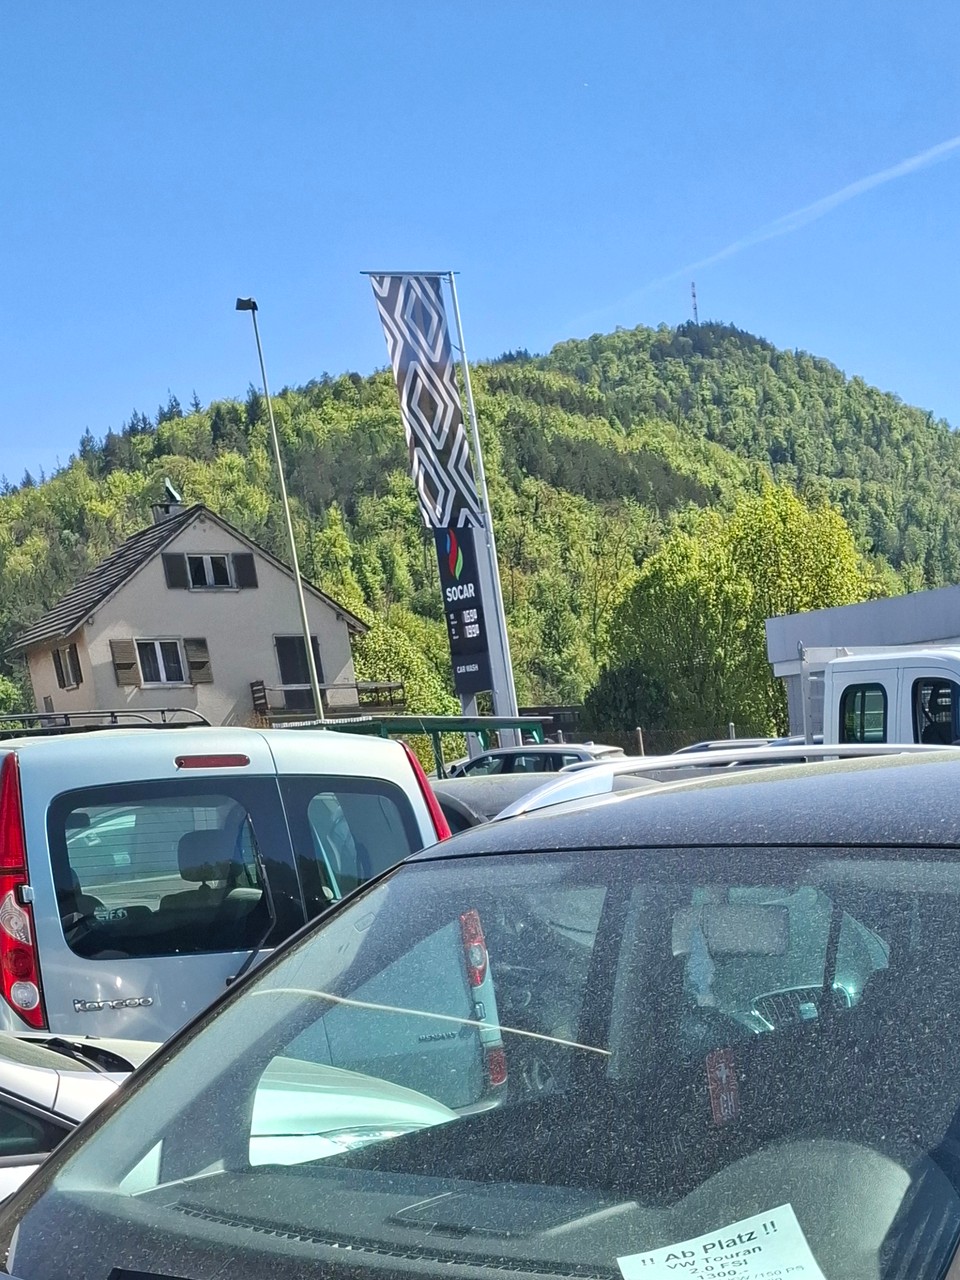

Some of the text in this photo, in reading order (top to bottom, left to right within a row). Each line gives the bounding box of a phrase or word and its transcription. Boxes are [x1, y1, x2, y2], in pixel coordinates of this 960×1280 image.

[446, 583, 475, 602] SOCAR
[665, 1250, 695, 1262] Ab
[702, 1230, 758, 1254] Platz
[762, 1220, 778, 1235] !!
[667, 1245, 762, 1270] VW Touran
[689, 1259, 749, 1275] 2.0 FSI
